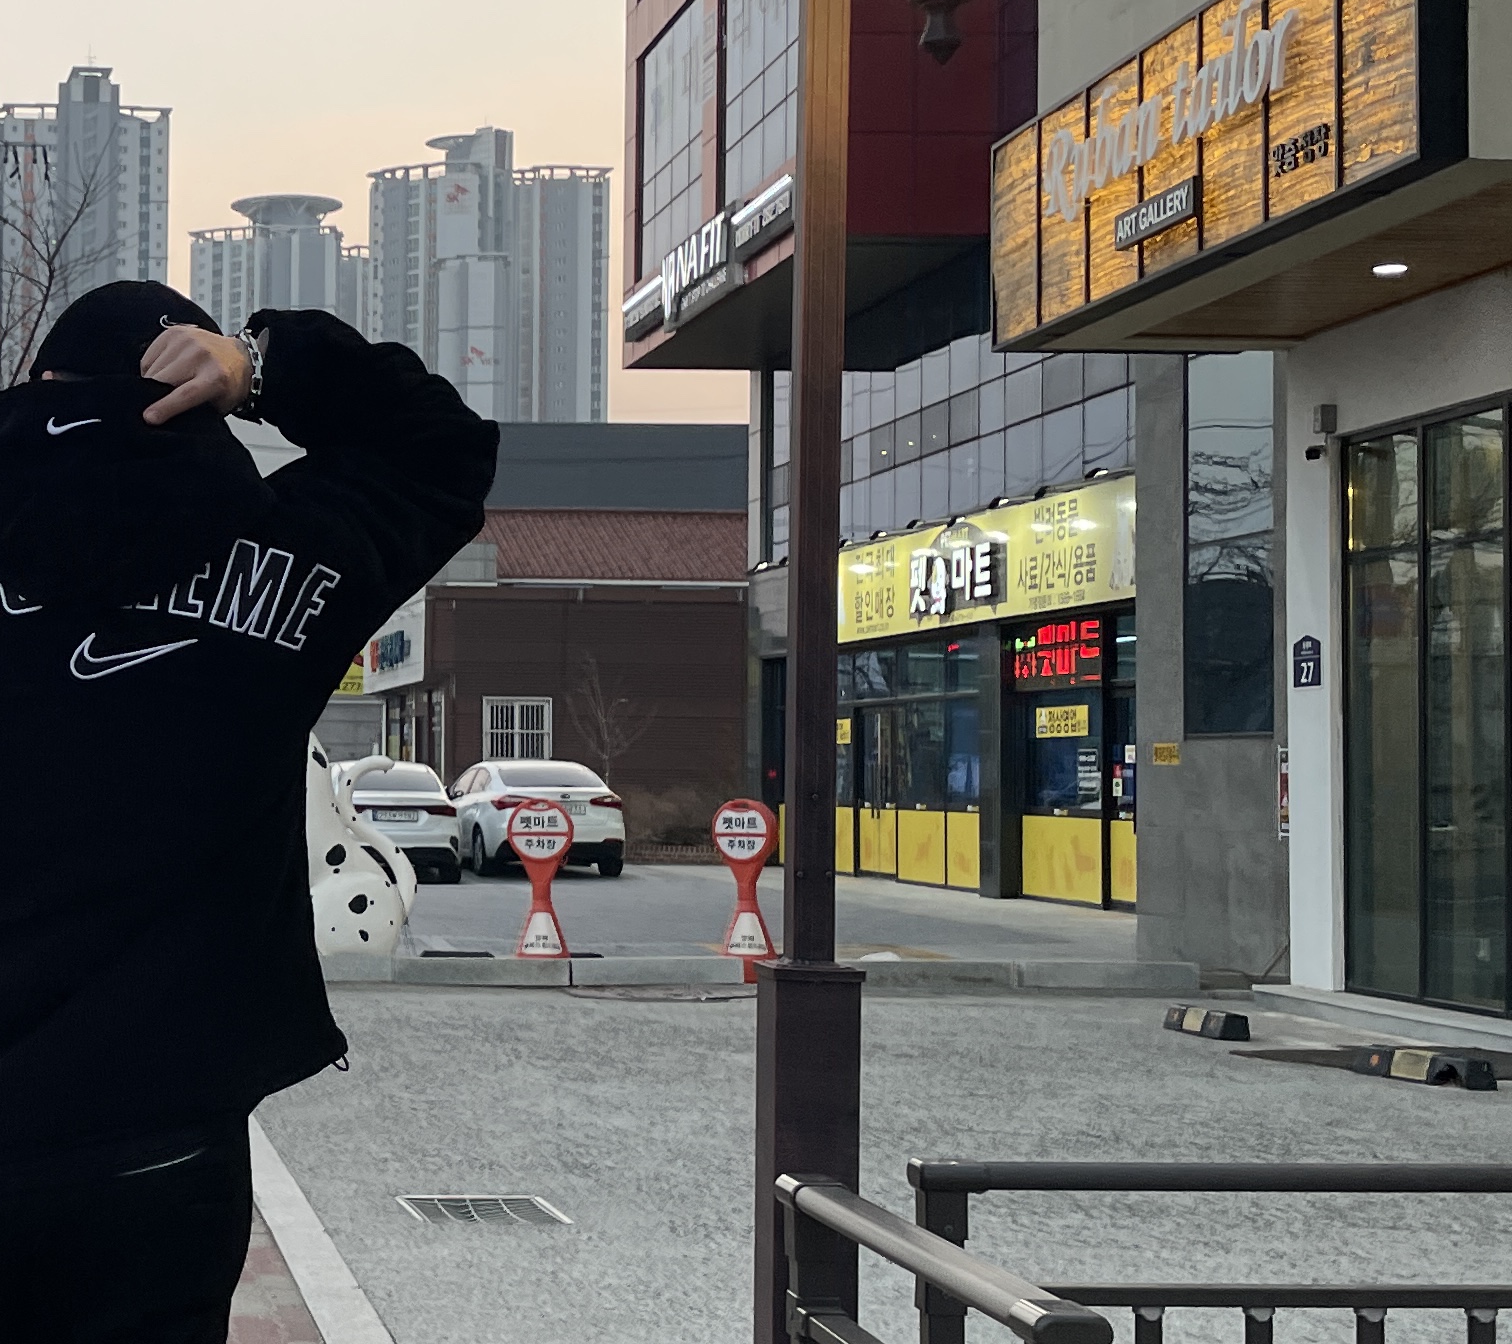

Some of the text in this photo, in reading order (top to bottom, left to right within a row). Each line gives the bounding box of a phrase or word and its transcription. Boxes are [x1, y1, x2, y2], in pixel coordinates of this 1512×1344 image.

[1044, 84, 1166, 223] Ruban
[1116, 184, 1190, 244] ART GALLERY
[854, 584, 896, 624] 할인매장
[1300, 661, 1314, 684] 27
[519, 815, 559, 830] 펫마트
[722, 816, 758, 830] 펫마트
[524, 838, 556, 851] 주차장
[727, 838, 756, 851] 주차장
